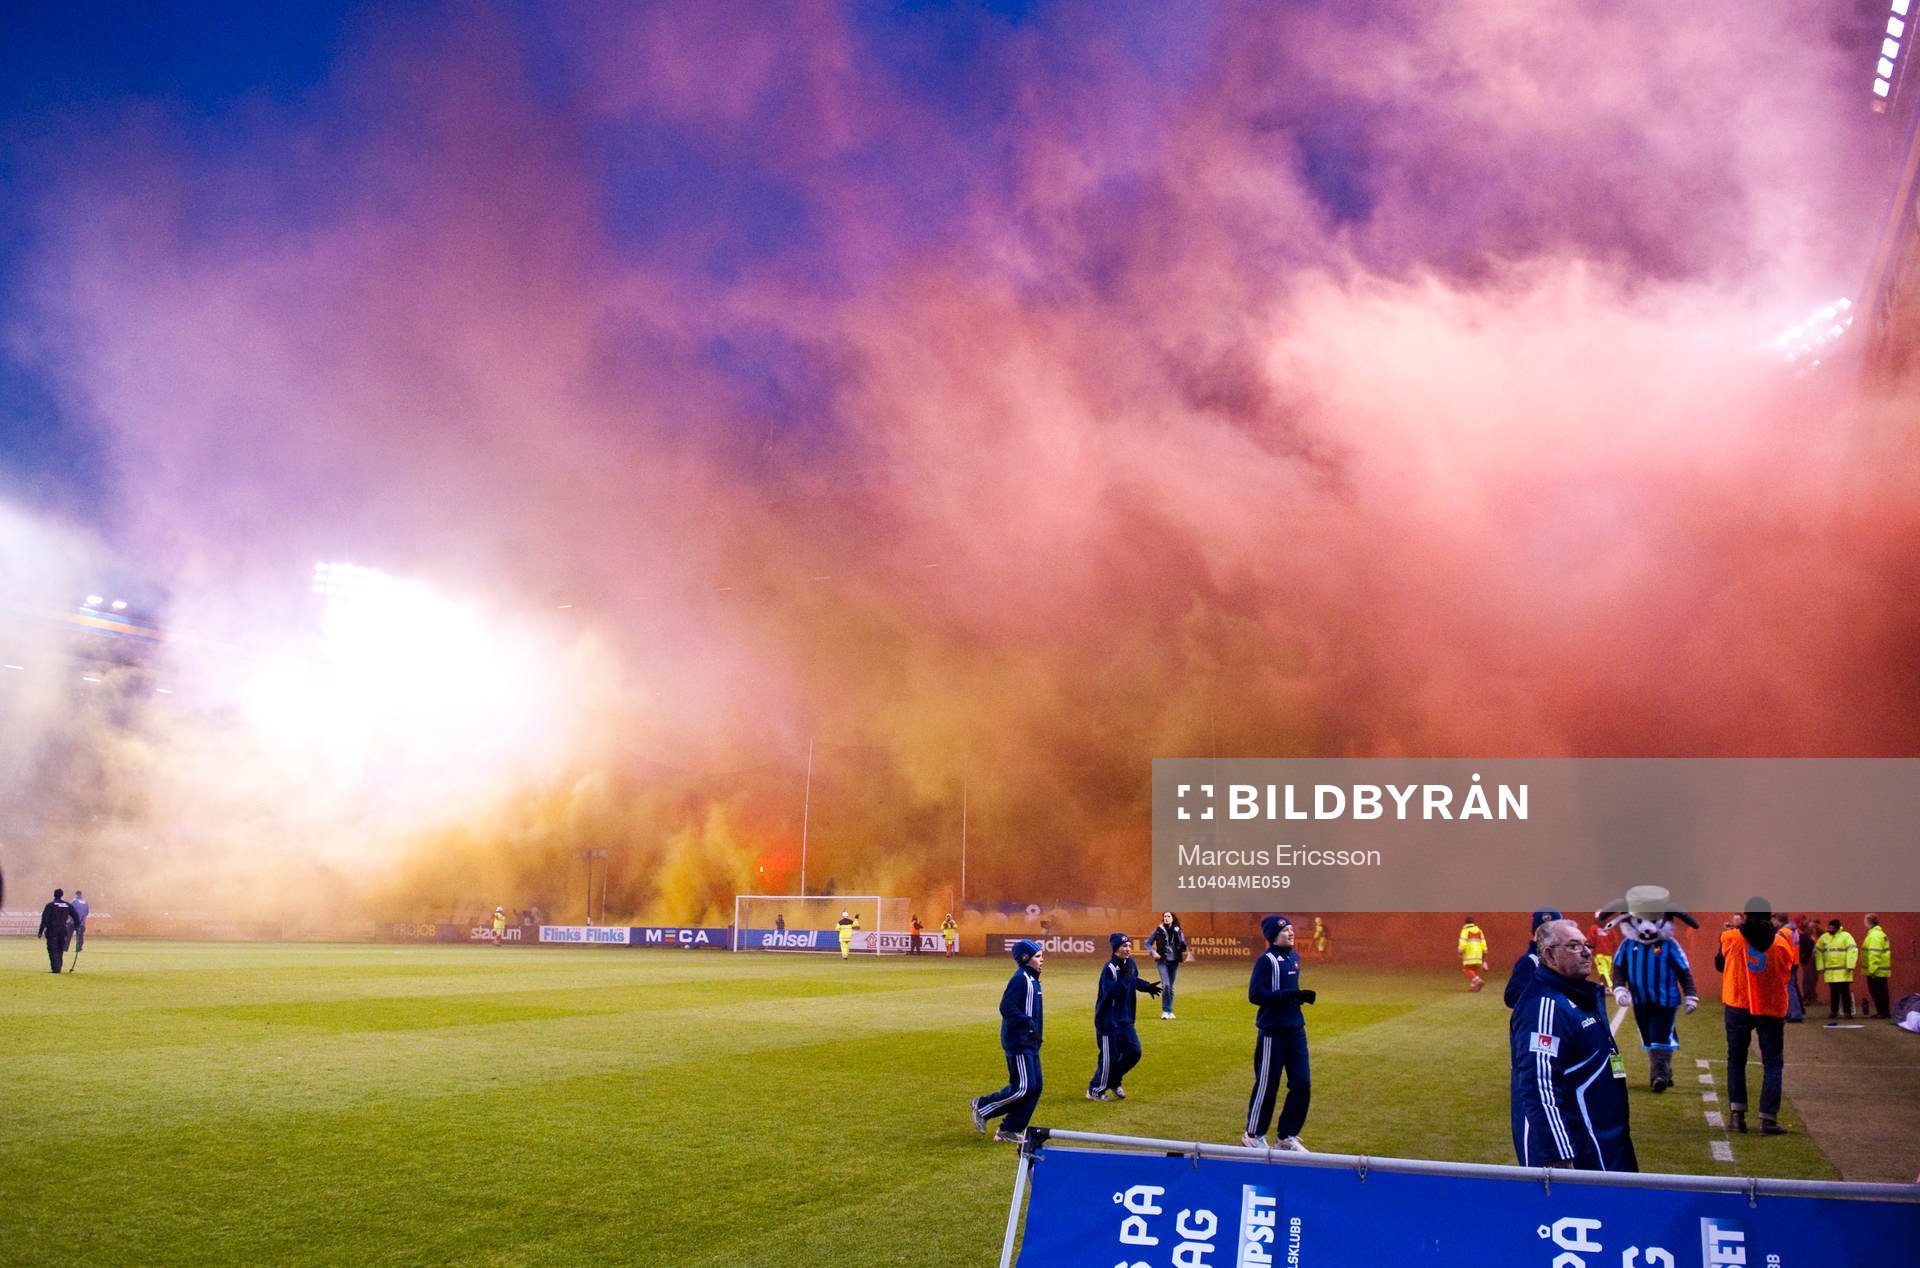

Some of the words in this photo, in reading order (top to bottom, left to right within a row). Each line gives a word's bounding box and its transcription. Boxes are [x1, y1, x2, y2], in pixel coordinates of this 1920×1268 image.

[543, 927, 581, 941] Flinks
[586, 928, 625, 942] Flinks
[762, 930, 818, 947] ahlsell
[880, 936, 935, 948] BYGA
[1190, 937, 1241, 946] MASKIN-
[1035, 935, 1096, 953] adidas
[1747, 943, 1767, 972] 5
[1112, 1184, 1166, 1246] PÅ
